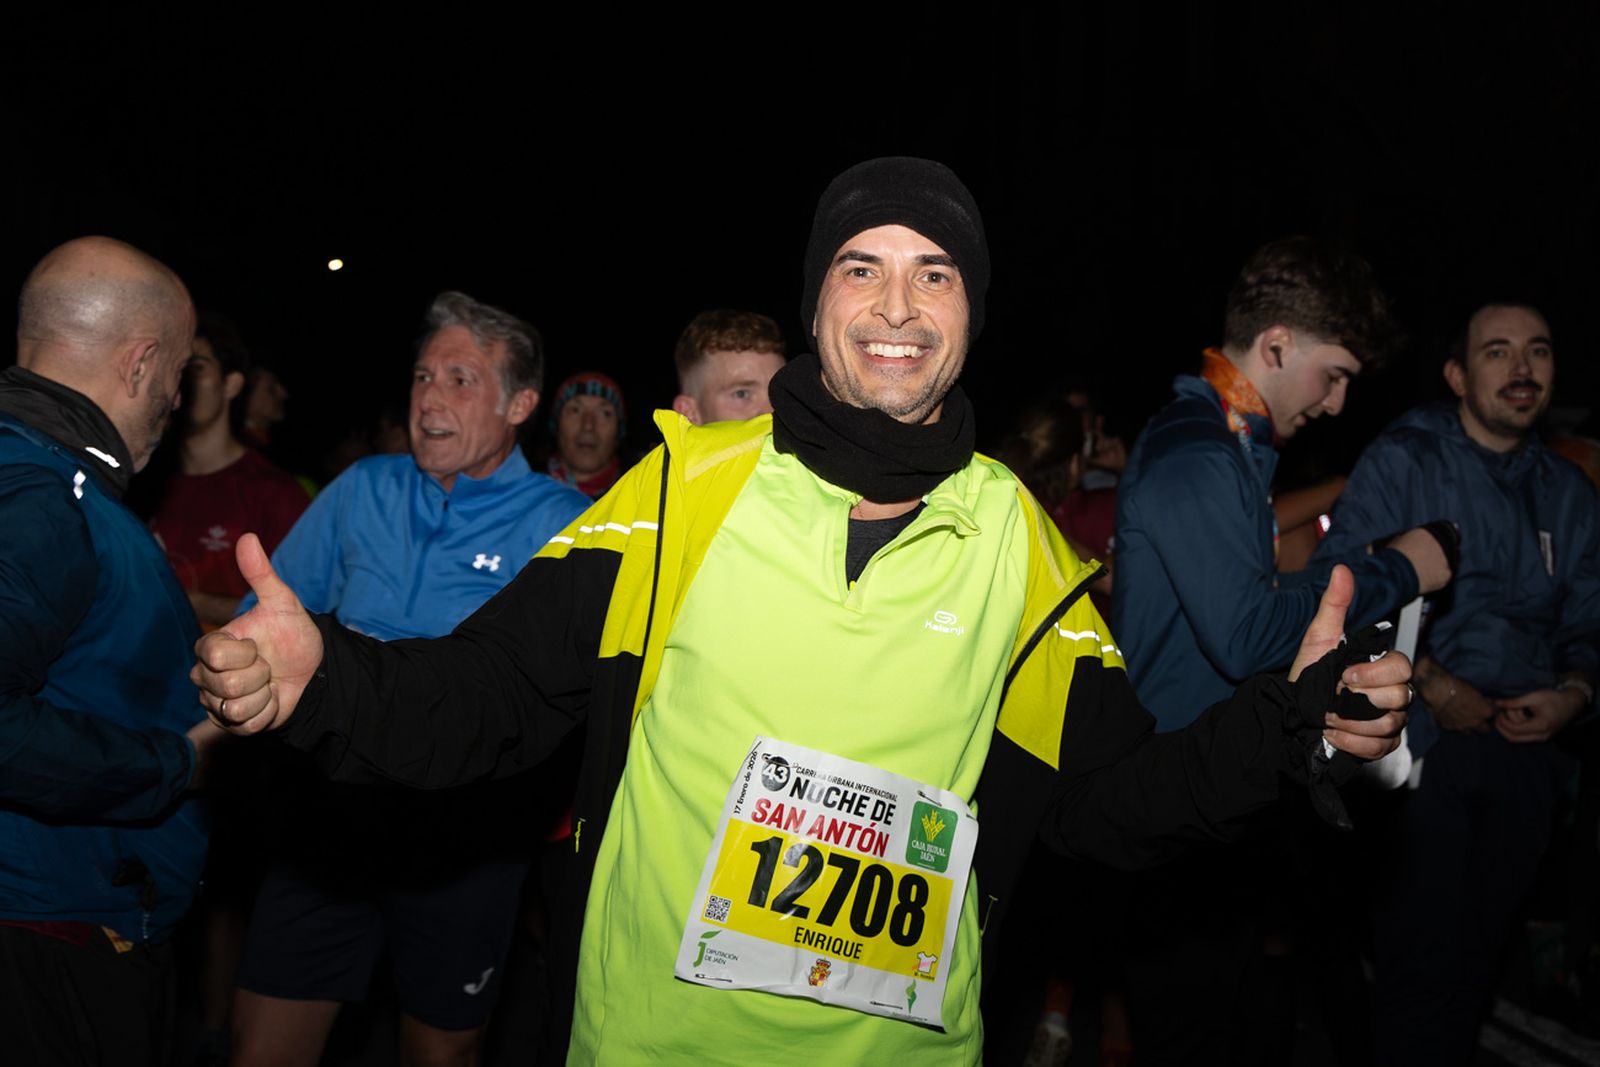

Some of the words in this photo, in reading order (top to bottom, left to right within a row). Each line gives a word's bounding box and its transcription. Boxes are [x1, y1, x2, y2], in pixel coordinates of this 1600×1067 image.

[744, 771, 751, 782] de
[763, 763, 788, 783] 43
[736, 783, 748, 804] Enero
[789, 777, 870, 818] NOCHE
[870, 799, 897, 826] DE
[855, 782, 898, 802] INTERNACIONAL
[734, 805, 741, 814] 17
[751, 798, 807, 833] SAN
[806, 814, 890, 858] ANTÓN
[746, 835, 930, 948] 12708
[793, 926, 865, 960] ENRIQUE
